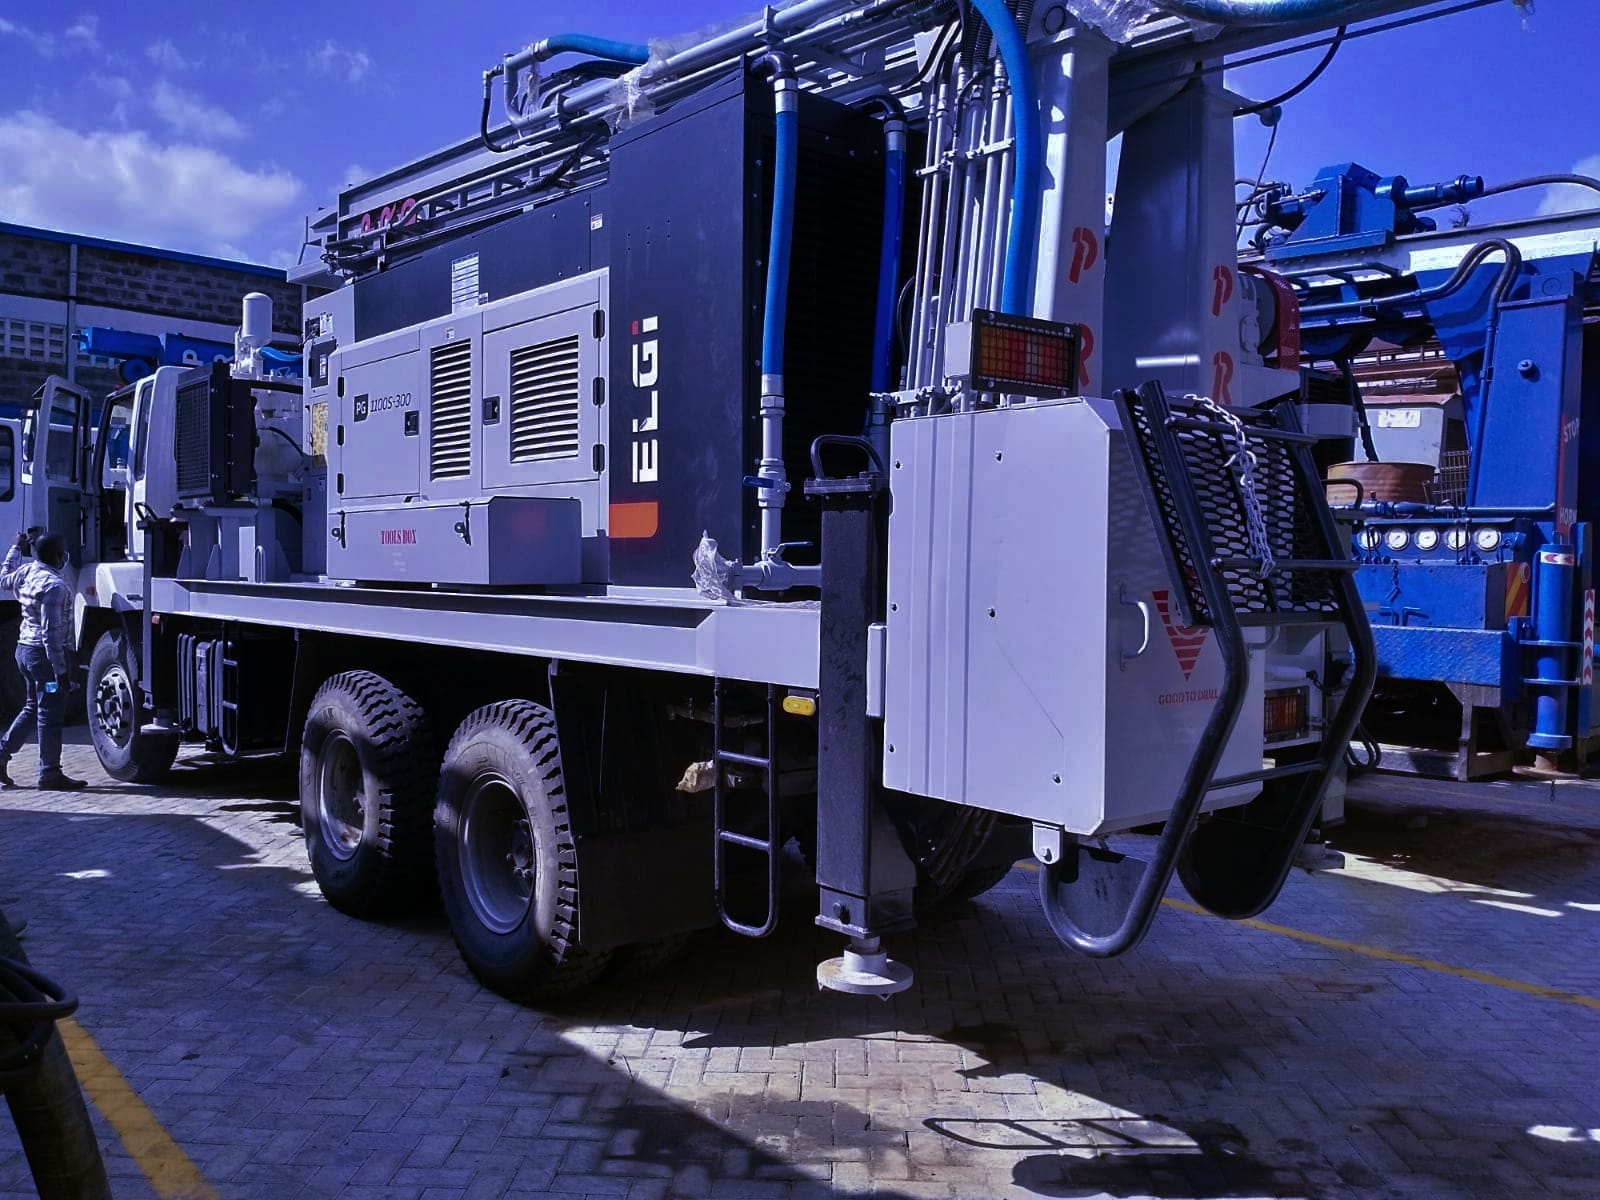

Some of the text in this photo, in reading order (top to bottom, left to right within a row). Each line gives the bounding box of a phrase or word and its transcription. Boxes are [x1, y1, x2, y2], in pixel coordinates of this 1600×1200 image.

[1069, 227, 1098, 284] P
[1212, 265, 1233, 317] P
[1212, 351, 1234, 405] R
[356, 392, 411, 416] PG 1100S-300
[381, 529, 417, 545] TOOLS BOX
[1158, 688, 1218, 705] GOOD TO DRILL
